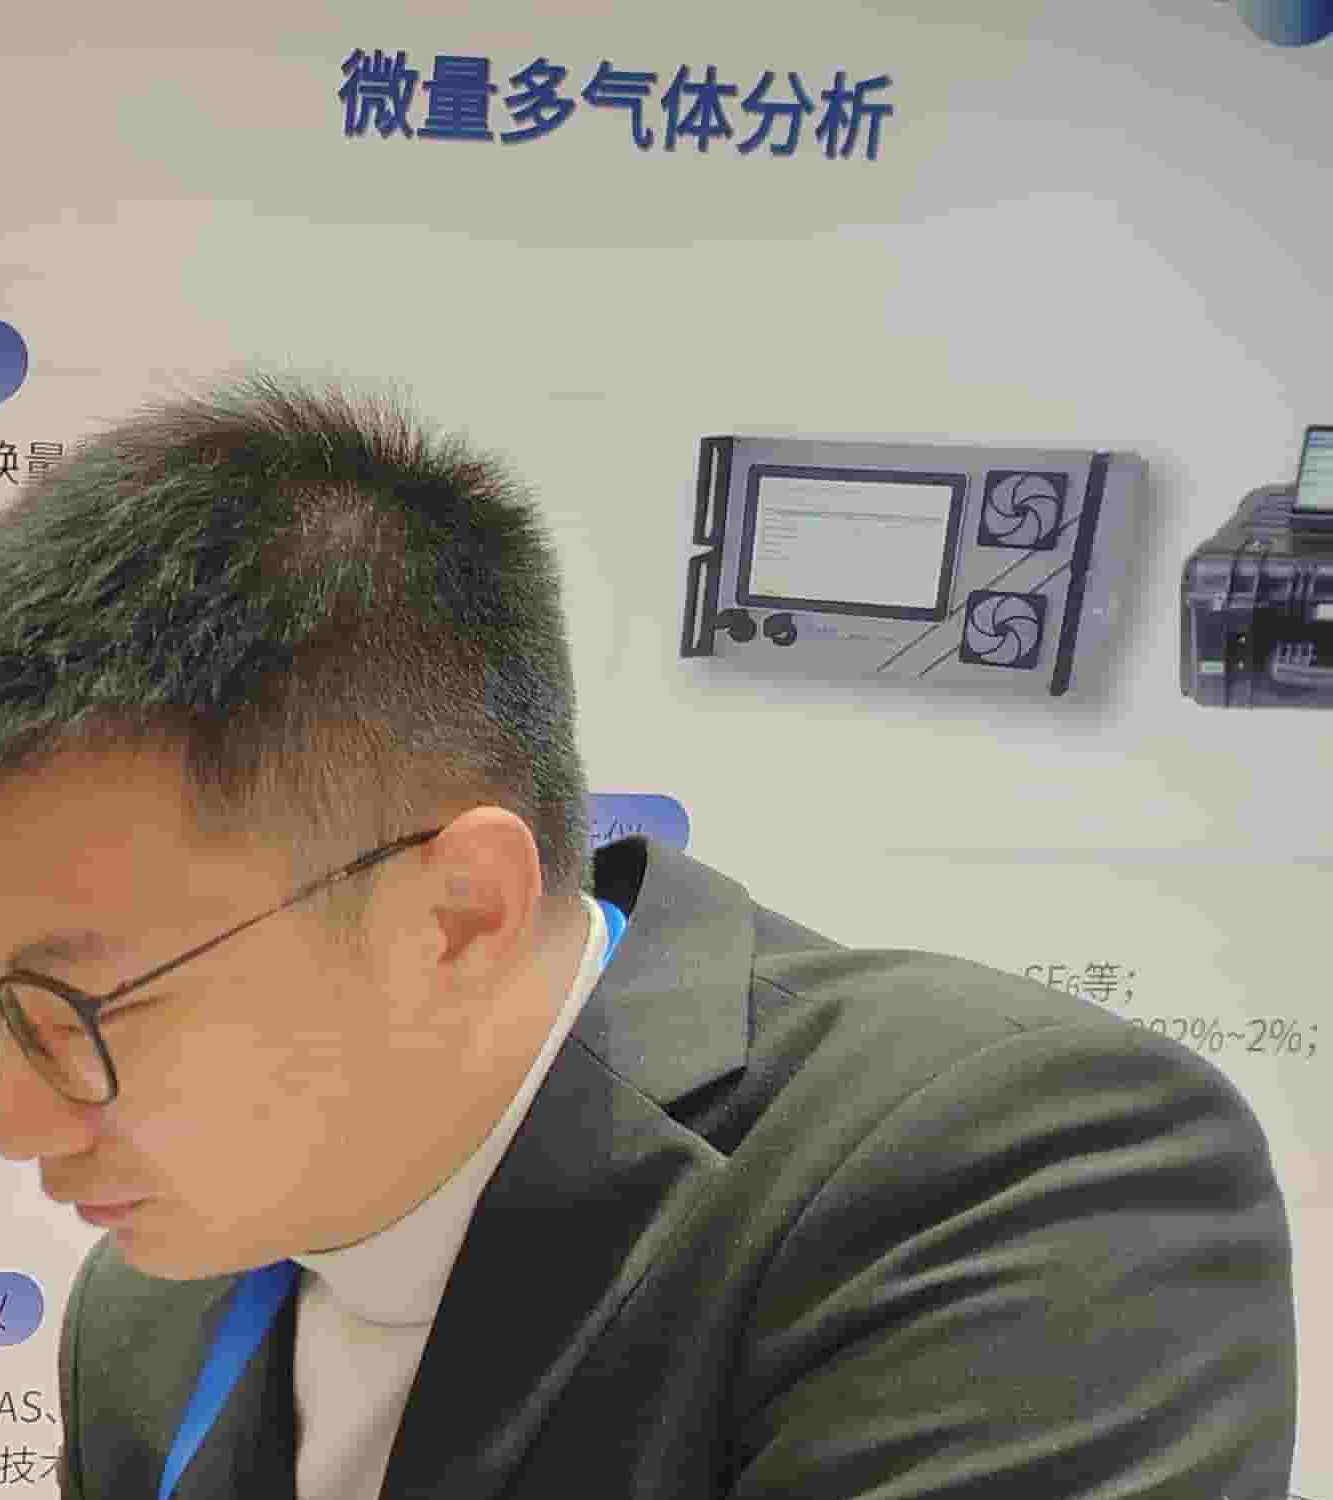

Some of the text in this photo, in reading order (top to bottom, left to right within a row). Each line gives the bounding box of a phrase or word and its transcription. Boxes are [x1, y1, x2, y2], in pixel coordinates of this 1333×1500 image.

[338, 47, 893, 161] 微量多气体分析
